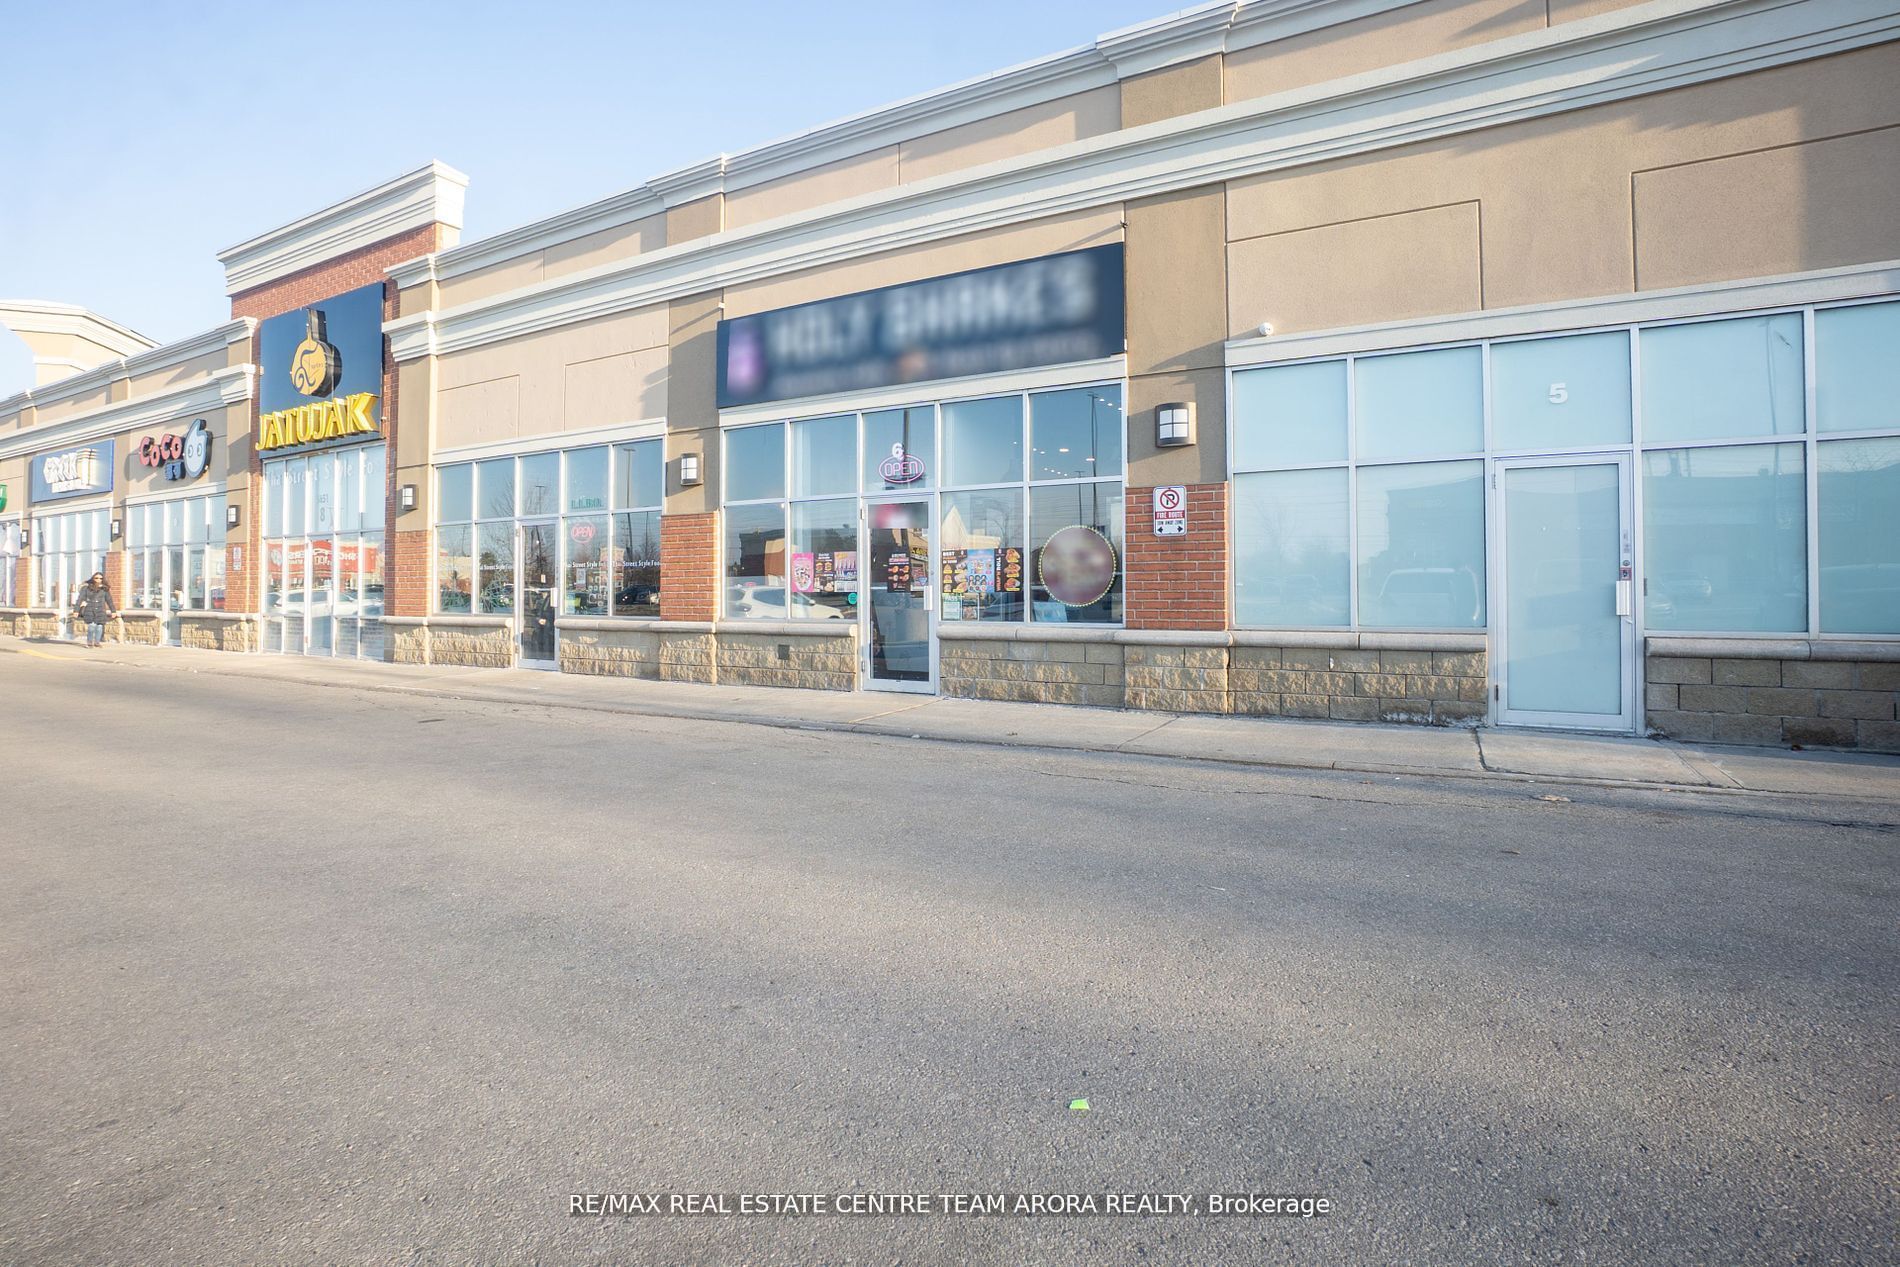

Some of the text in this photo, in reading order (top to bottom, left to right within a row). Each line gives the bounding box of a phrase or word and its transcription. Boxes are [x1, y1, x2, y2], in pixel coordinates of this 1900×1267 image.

[1549, 383, 1568, 404] 5
[255, 393, 377, 451] JATUJAK
[892, 442, 904, 460] 6
[884, 462, 918, 477] OPEN
[573, 526, 593, 538] OPEN
